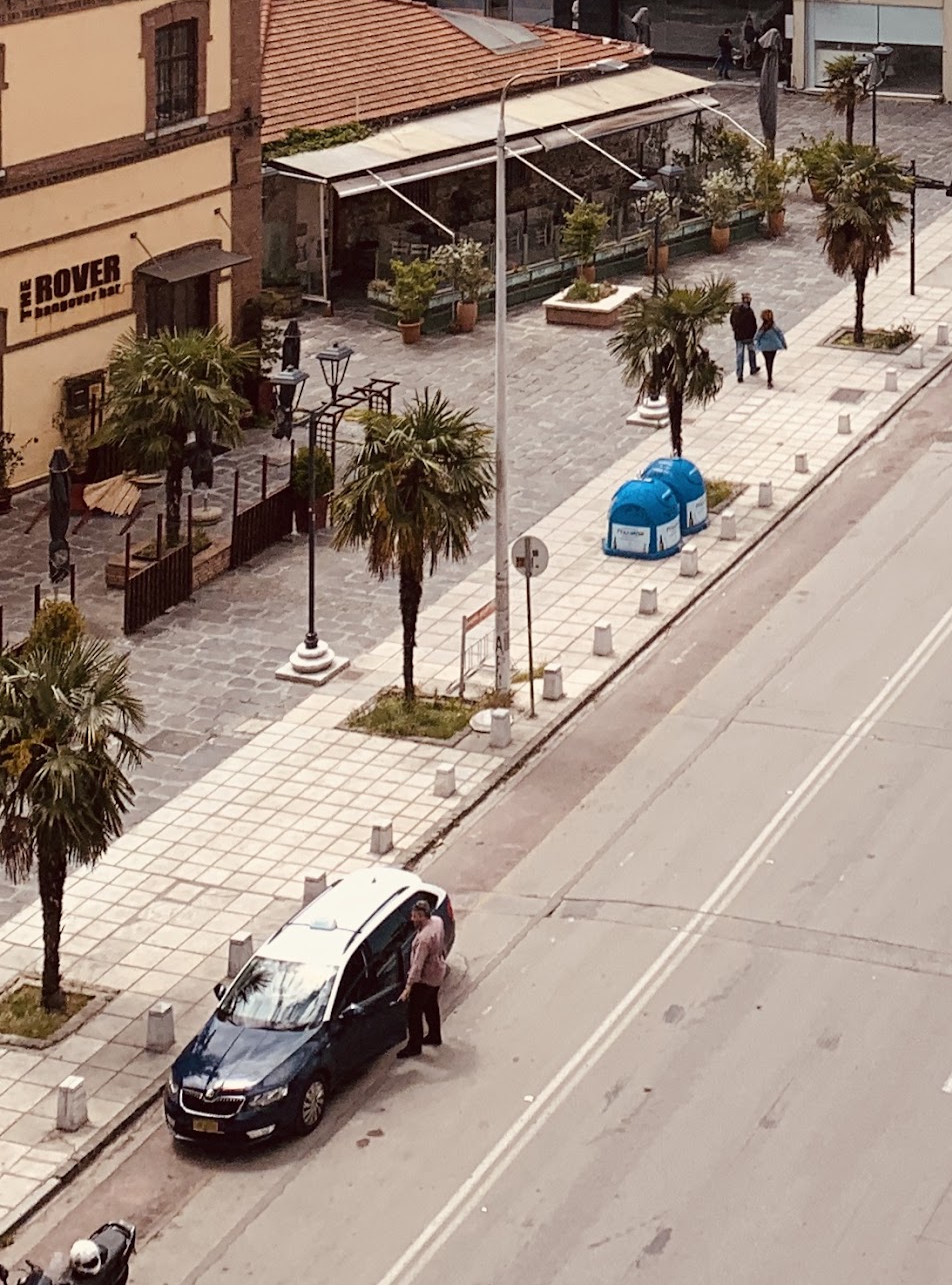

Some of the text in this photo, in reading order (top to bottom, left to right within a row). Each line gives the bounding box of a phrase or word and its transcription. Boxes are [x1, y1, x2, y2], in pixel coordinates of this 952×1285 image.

[20, 279, 31, 323] THE
[35, 254, 120, 305] ROVER
[99, 283, 120, 300] bar
